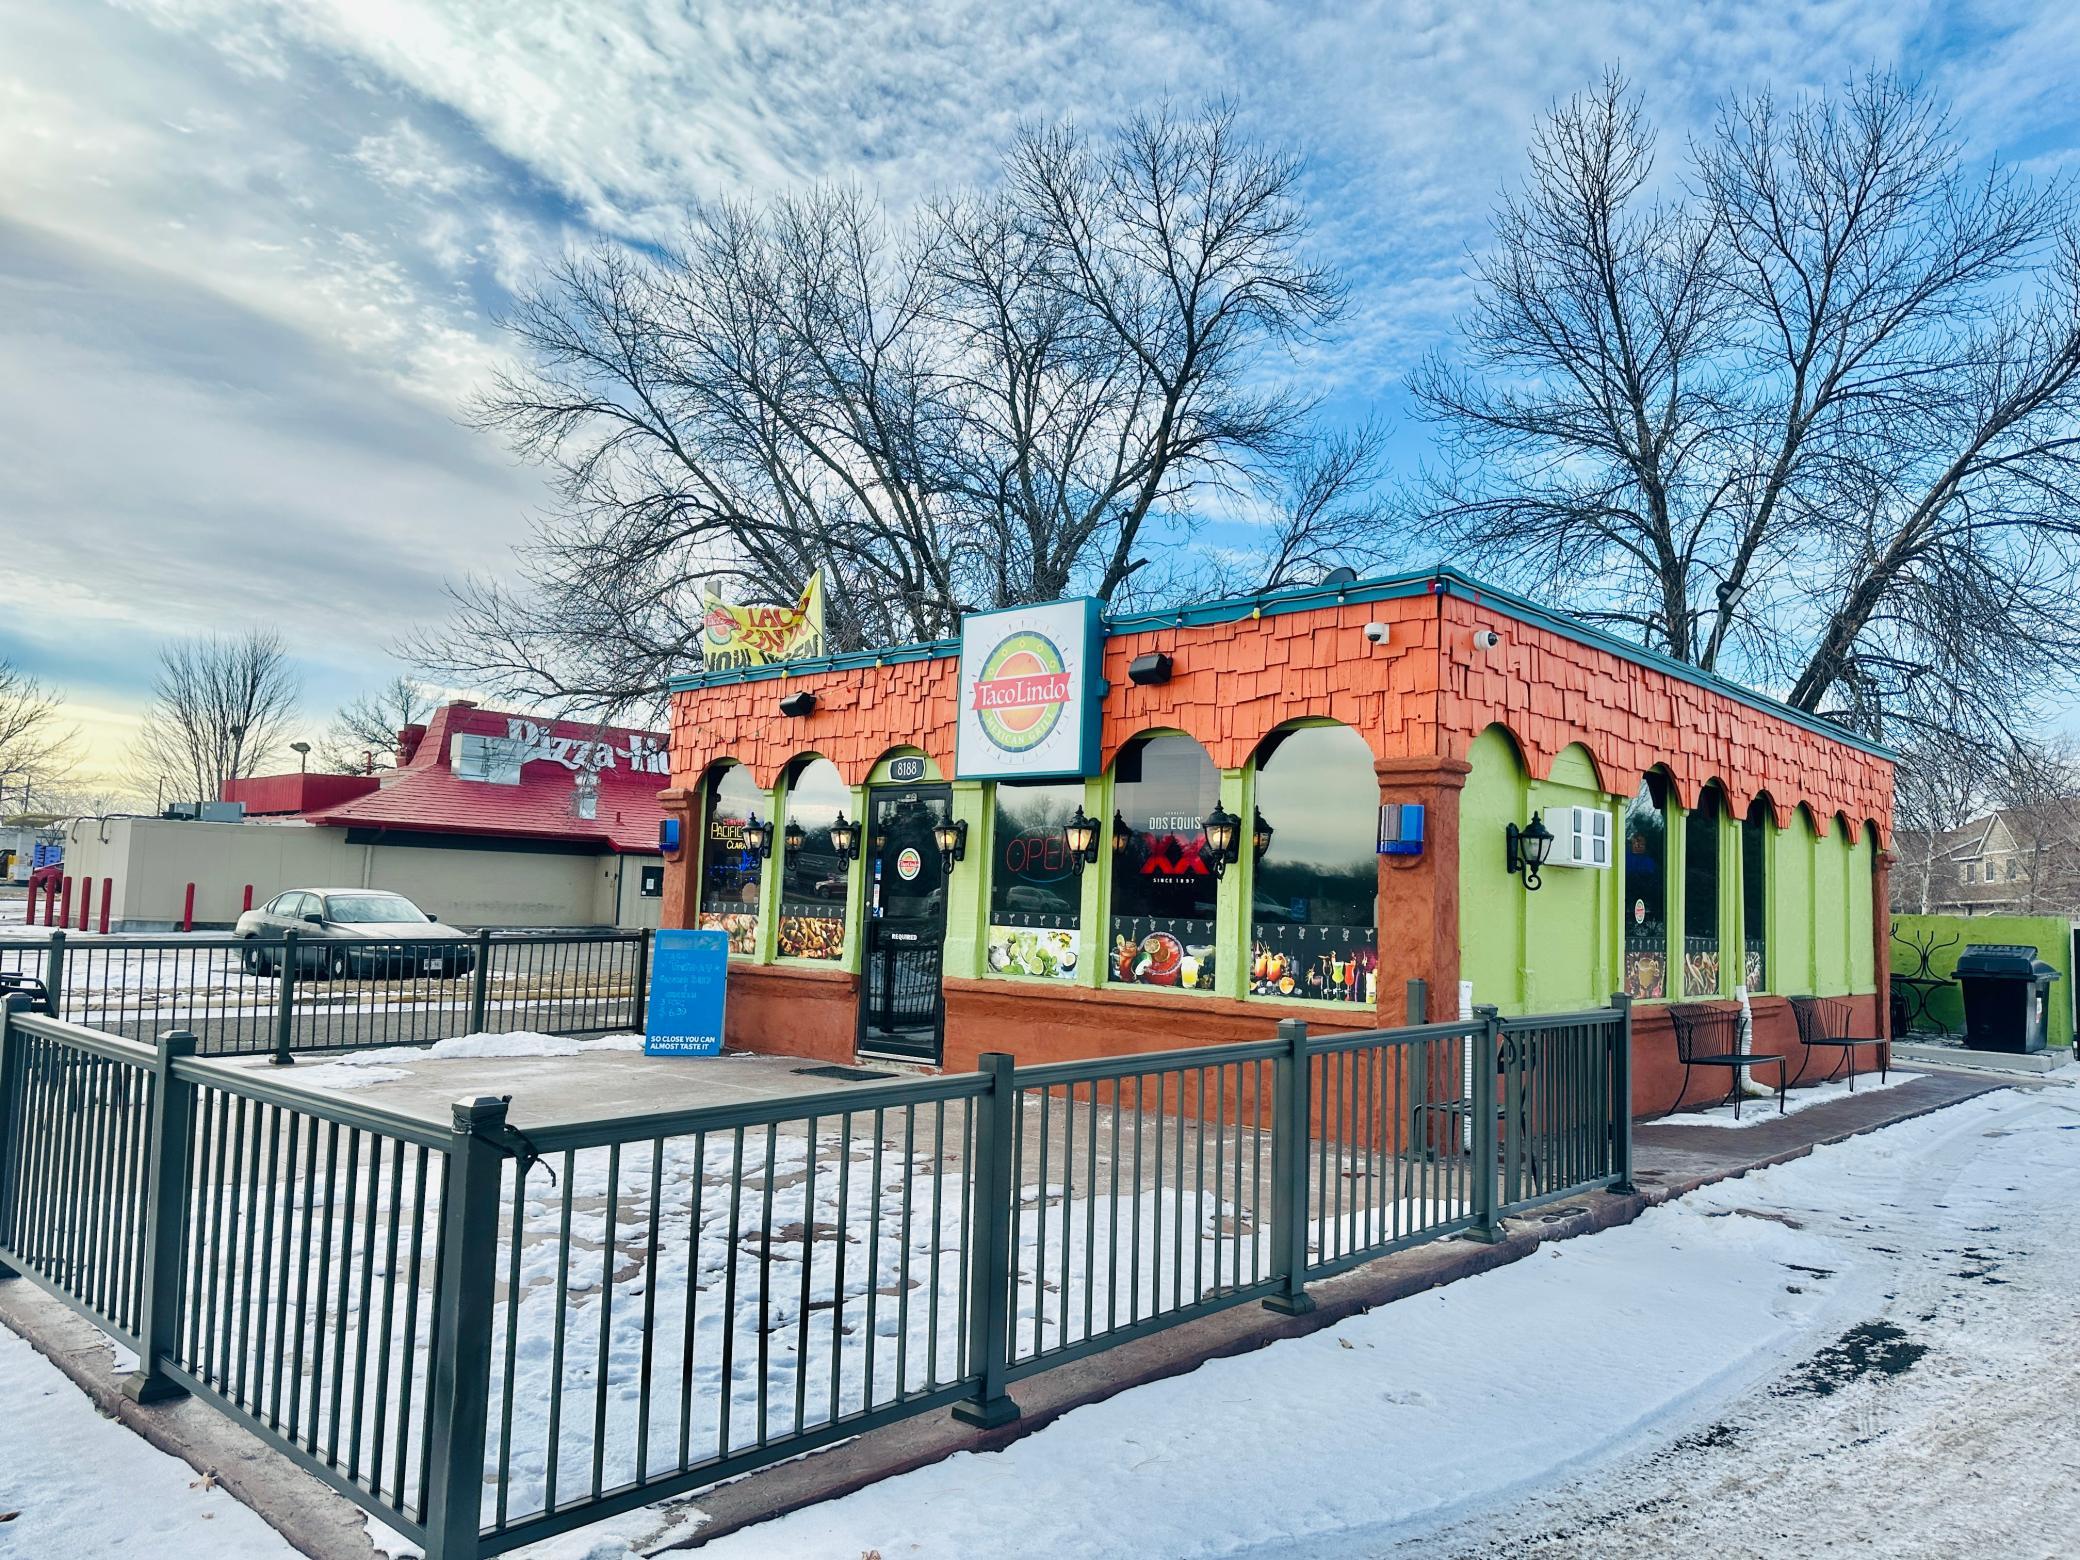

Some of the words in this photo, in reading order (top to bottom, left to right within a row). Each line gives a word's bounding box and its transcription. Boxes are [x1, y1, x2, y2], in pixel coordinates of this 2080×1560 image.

[897, 761, 917, 776] 8188
[711, 822, 747, 839] PACIFIC
[1149, 816, 1169, 830] DOS
[1170, 816, 1201, 831] EQUIS
[1140, 832, 1210, 875] XX
[891, 933, 918, 941] REQUIRED
